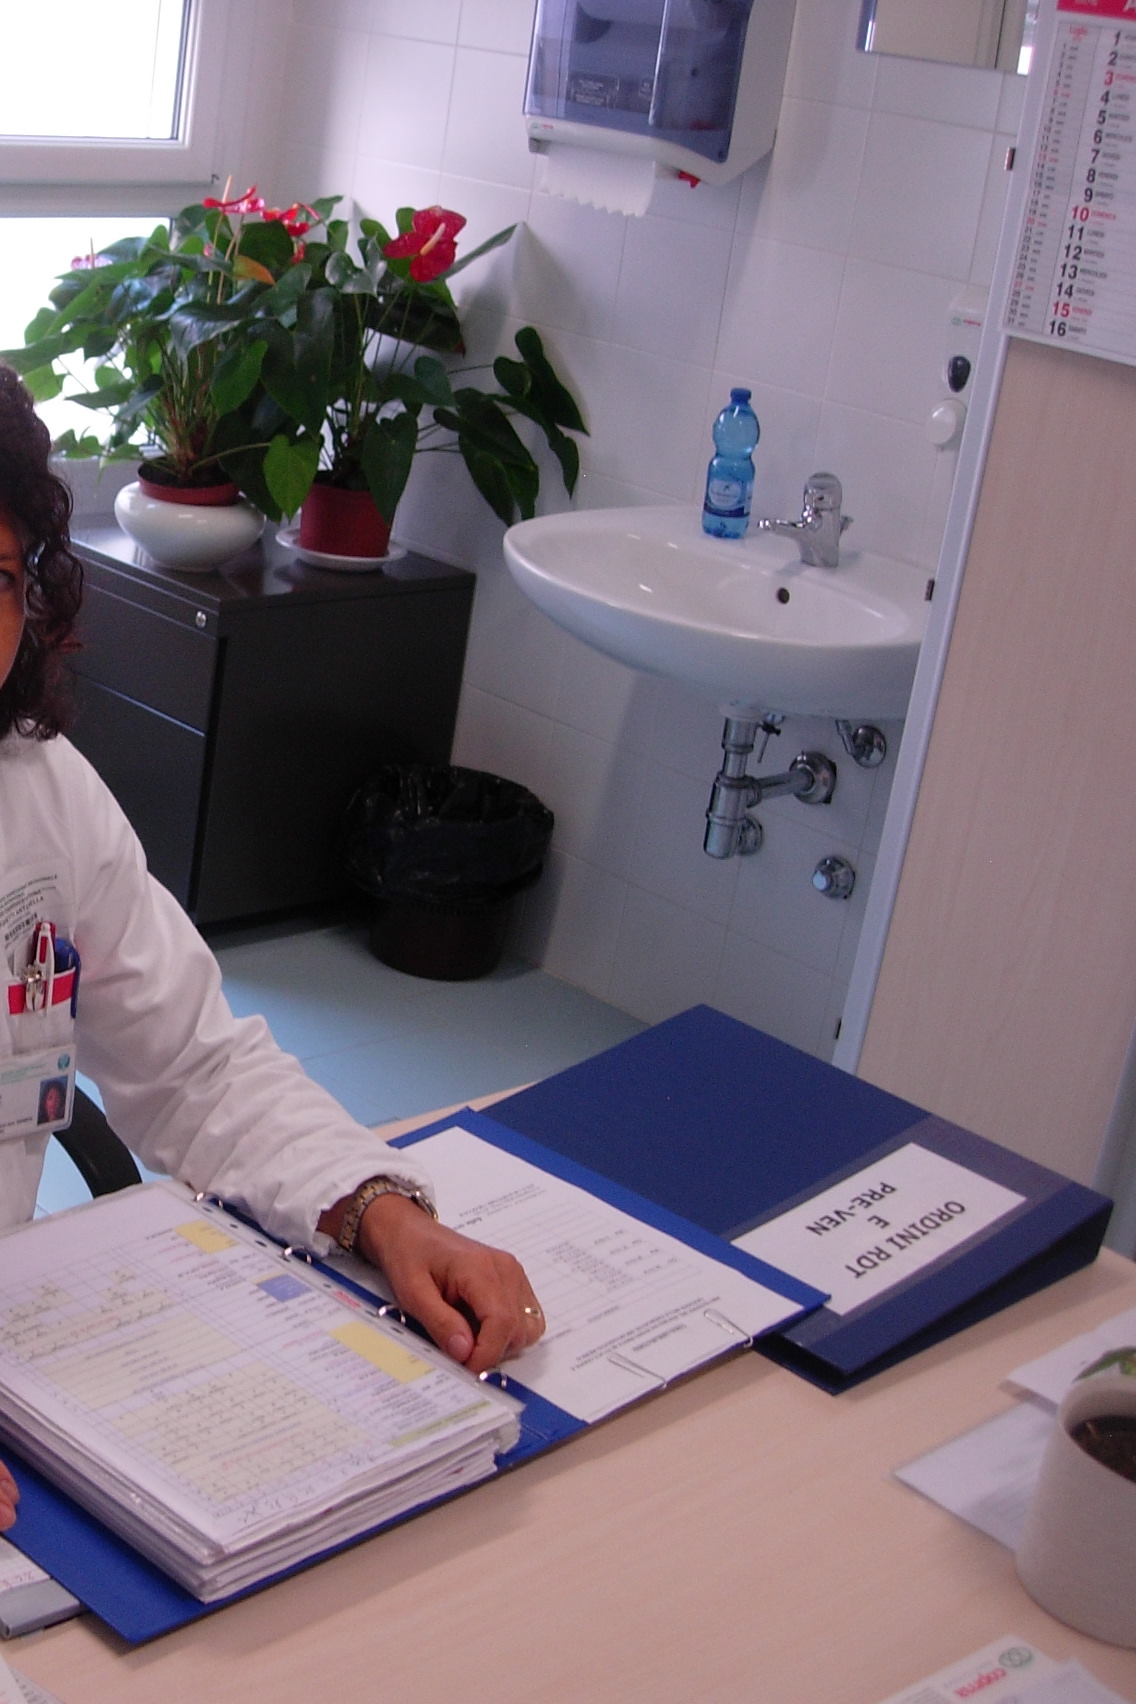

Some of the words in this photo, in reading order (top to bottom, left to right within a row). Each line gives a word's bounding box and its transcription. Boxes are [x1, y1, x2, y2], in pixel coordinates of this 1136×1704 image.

[1114, 30, 1122, 45] 1
[1108, 51, 1118, 66] 2
[1104, 70, 1114, 86] 3
[1100, 90, 1110, 106] 4
[1096, 110, 1107, 125] 5
[1093, 129, 1103, 144] 6
[1091, 149, 1100, 164] 7
[1086, 168, 1096, 184] 8
[1084, 187, 1093, 202] 9
[1072, 206, 1090, 222] 10
[1068, 224, 1084, 241] 11
[1064, 244, 1082, 261] 12
[1060, 263, 1078, 280] 13
[1056, 282, 1073, 298] 14
[1053, 301, 1070, 318] 15
[1049, 320, 1066, 337] 16
[805, 1181, 897, 1237] PRE-VEN
[867, 1214, 891, 1229] E
[885, 1200, 966, 1250] ORDINI
[844, 1246, 892, 1279] RDT
